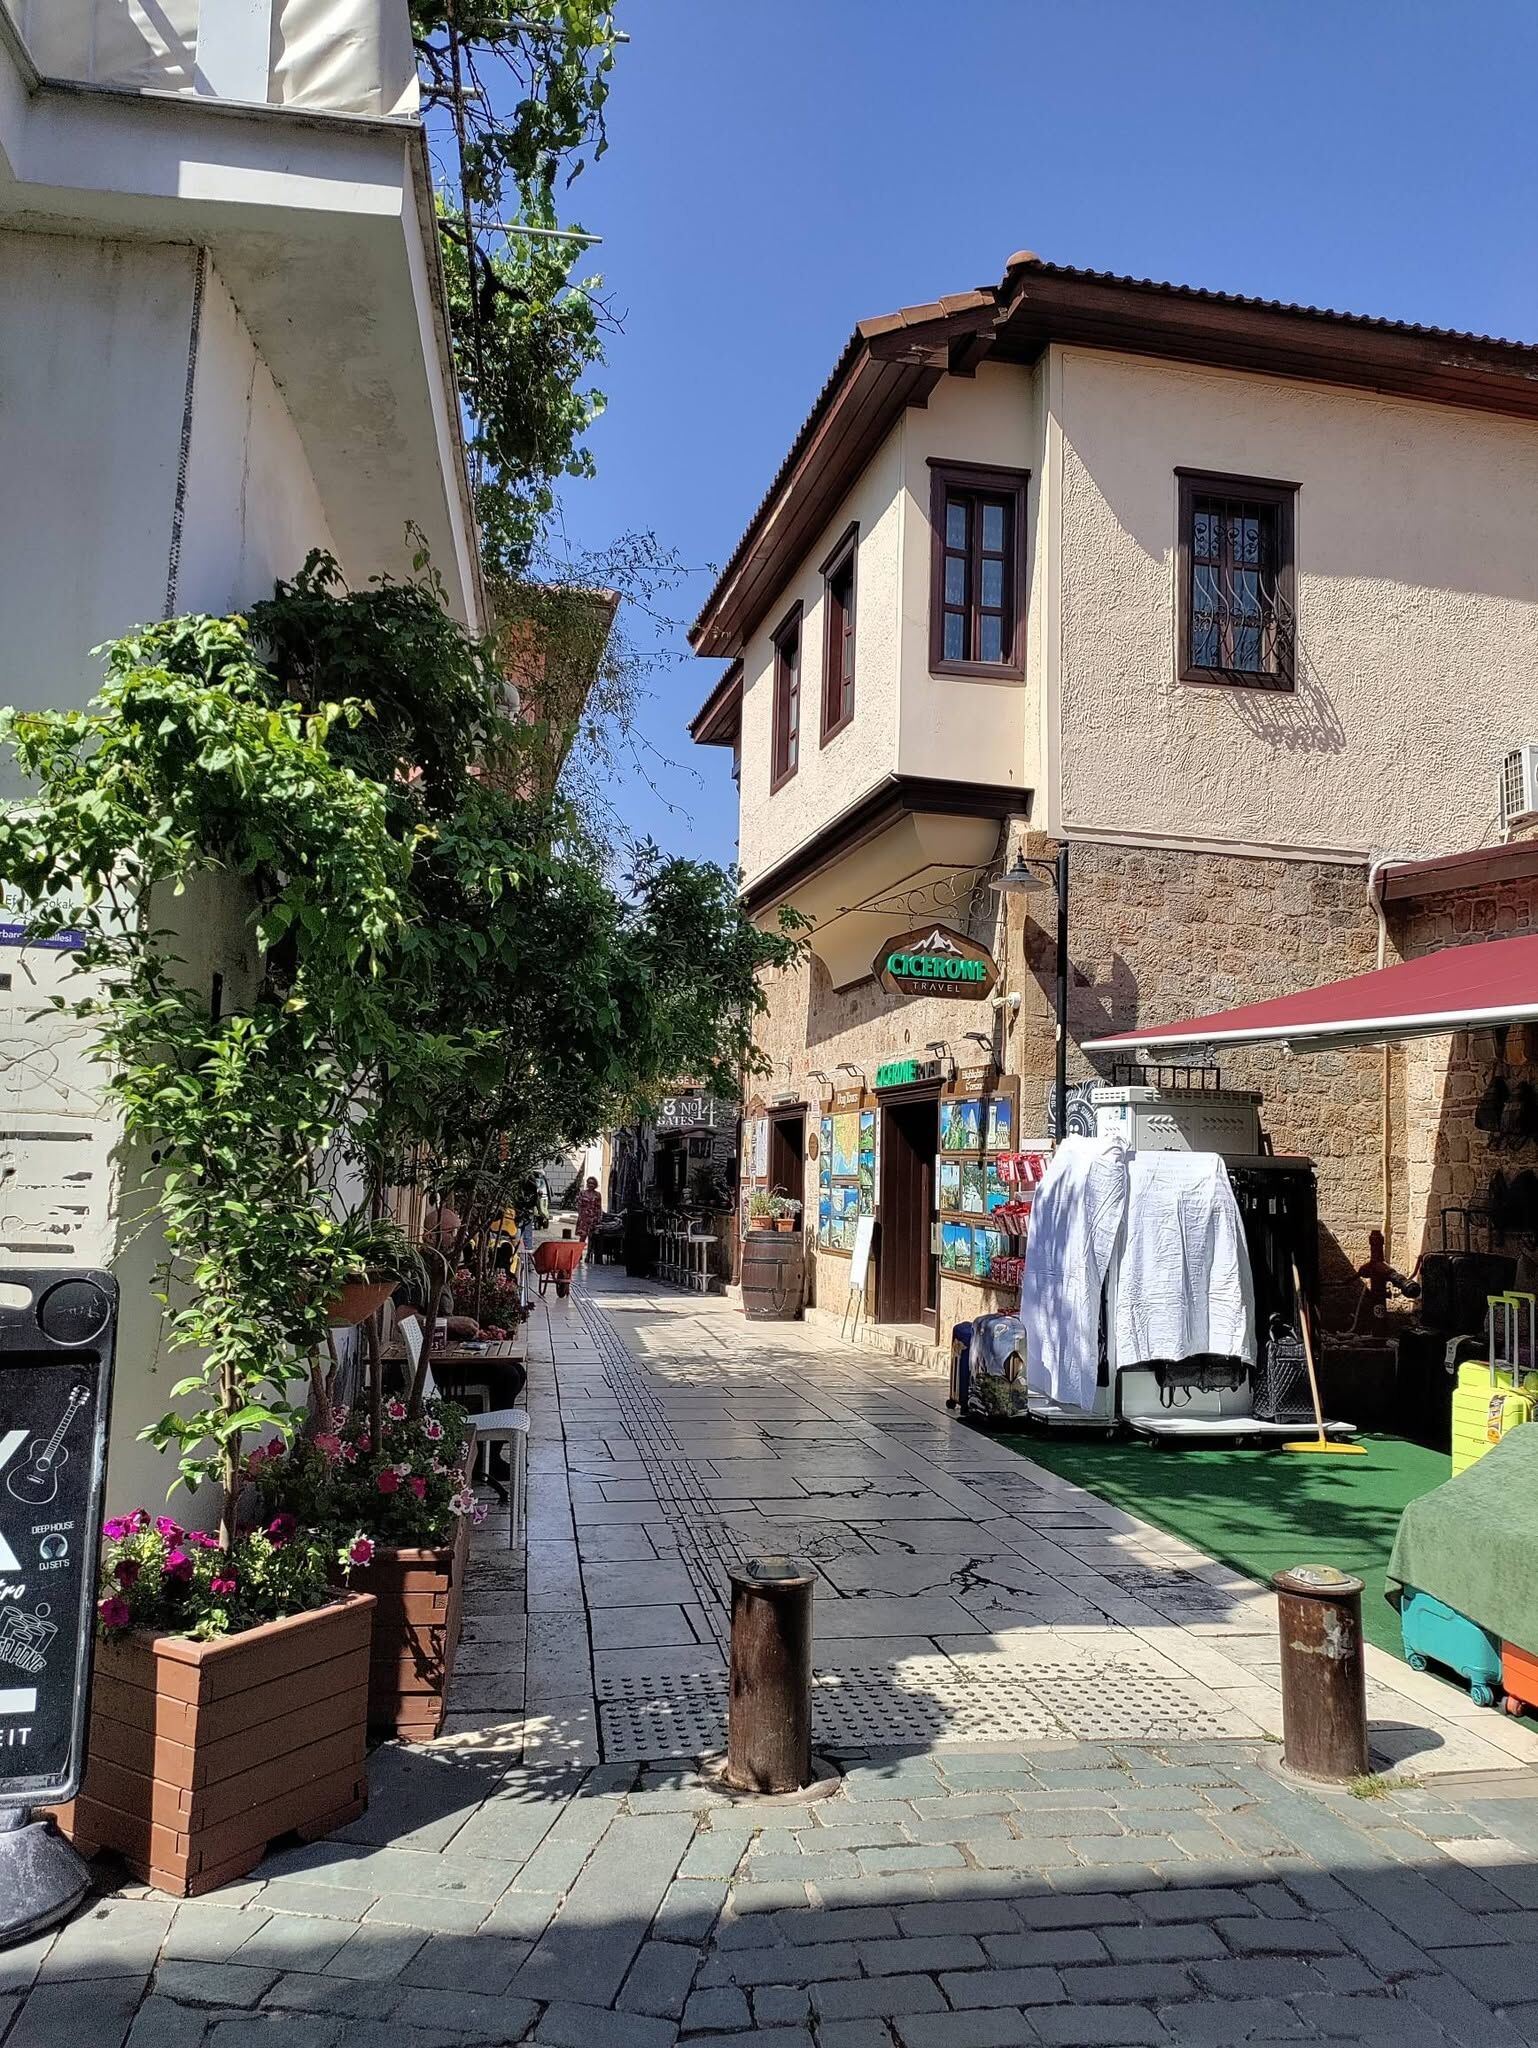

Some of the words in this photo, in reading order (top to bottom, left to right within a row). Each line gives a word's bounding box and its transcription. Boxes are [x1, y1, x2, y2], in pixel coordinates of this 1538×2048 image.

[43, 898, 75, 909] Sokak
[887, 953, 987, 981] CICERONE
[913, 981, 961, 993] TRAVEL
[663, 1098, 677, 1116] 3
[657, 1115, 694, 1127] GATES
[31, 1523, 50, 1535] DEEP
[50, 1520, 75, 1532] HOUSE
[39, 1561, 50, 1571] DJ
[50, 1558, 70, 1570] SET'S
[9, 1640, 47, 1673] PONG
